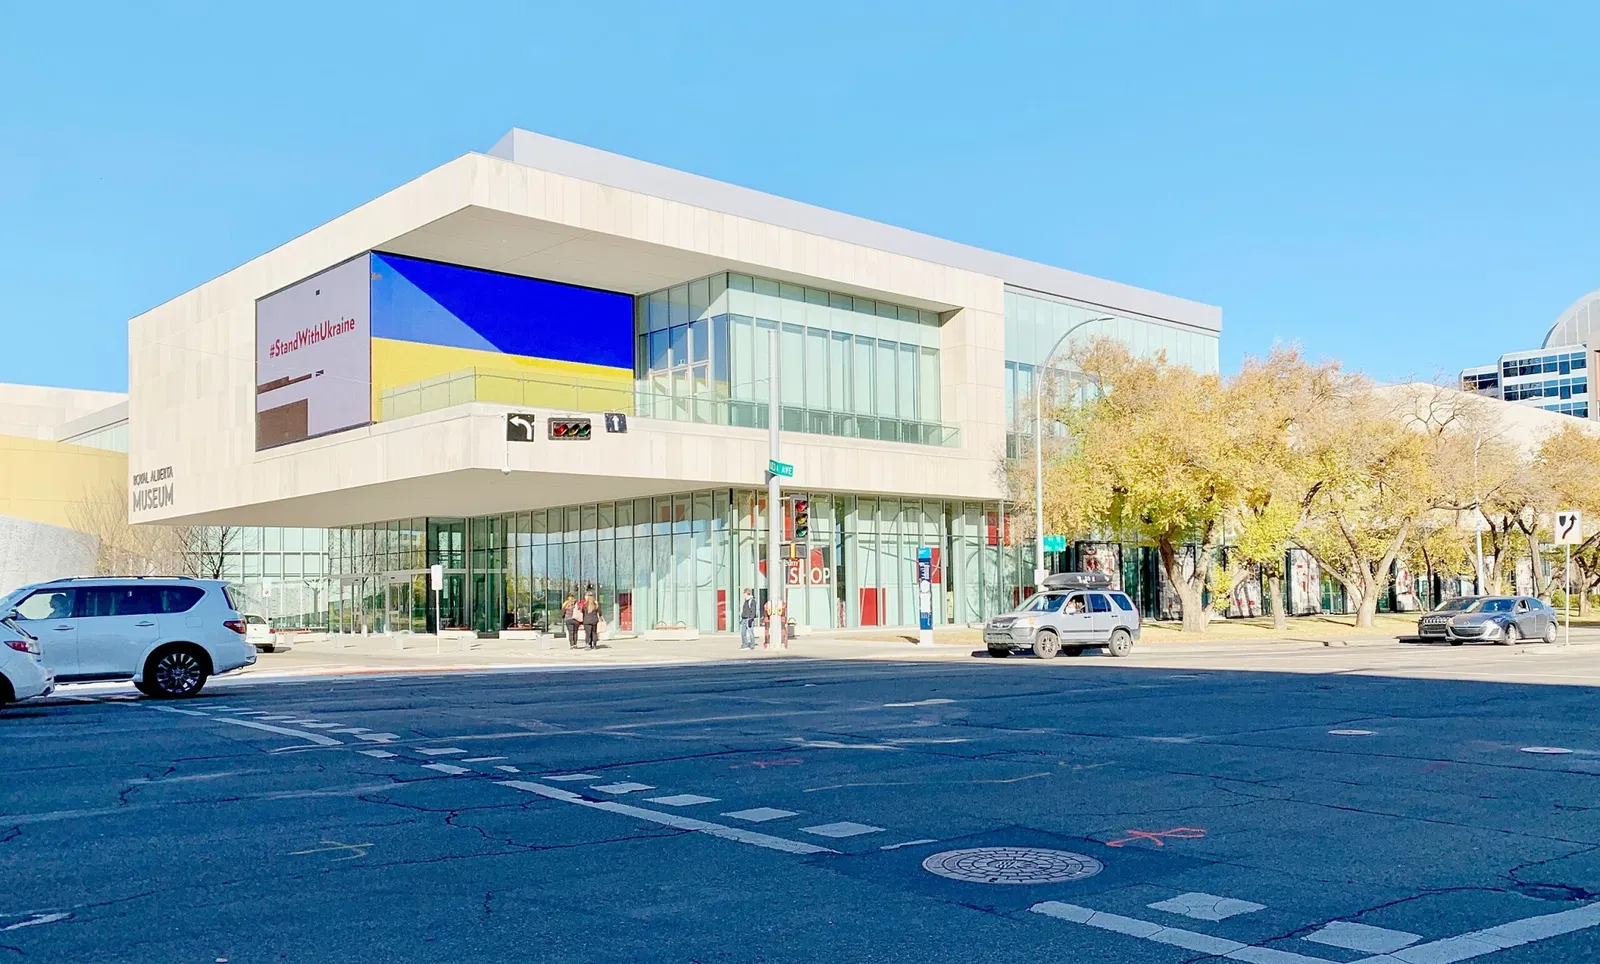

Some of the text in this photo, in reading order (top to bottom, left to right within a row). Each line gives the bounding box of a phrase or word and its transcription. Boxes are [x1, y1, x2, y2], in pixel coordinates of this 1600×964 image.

[269, 316, 355, 359] #StandWithUkraine
[133, 465, 173, 486] ROYAL ALBERTA
[782, 464, 793, 475] AVE
[133, 482, 174, 512] MUSEUM
